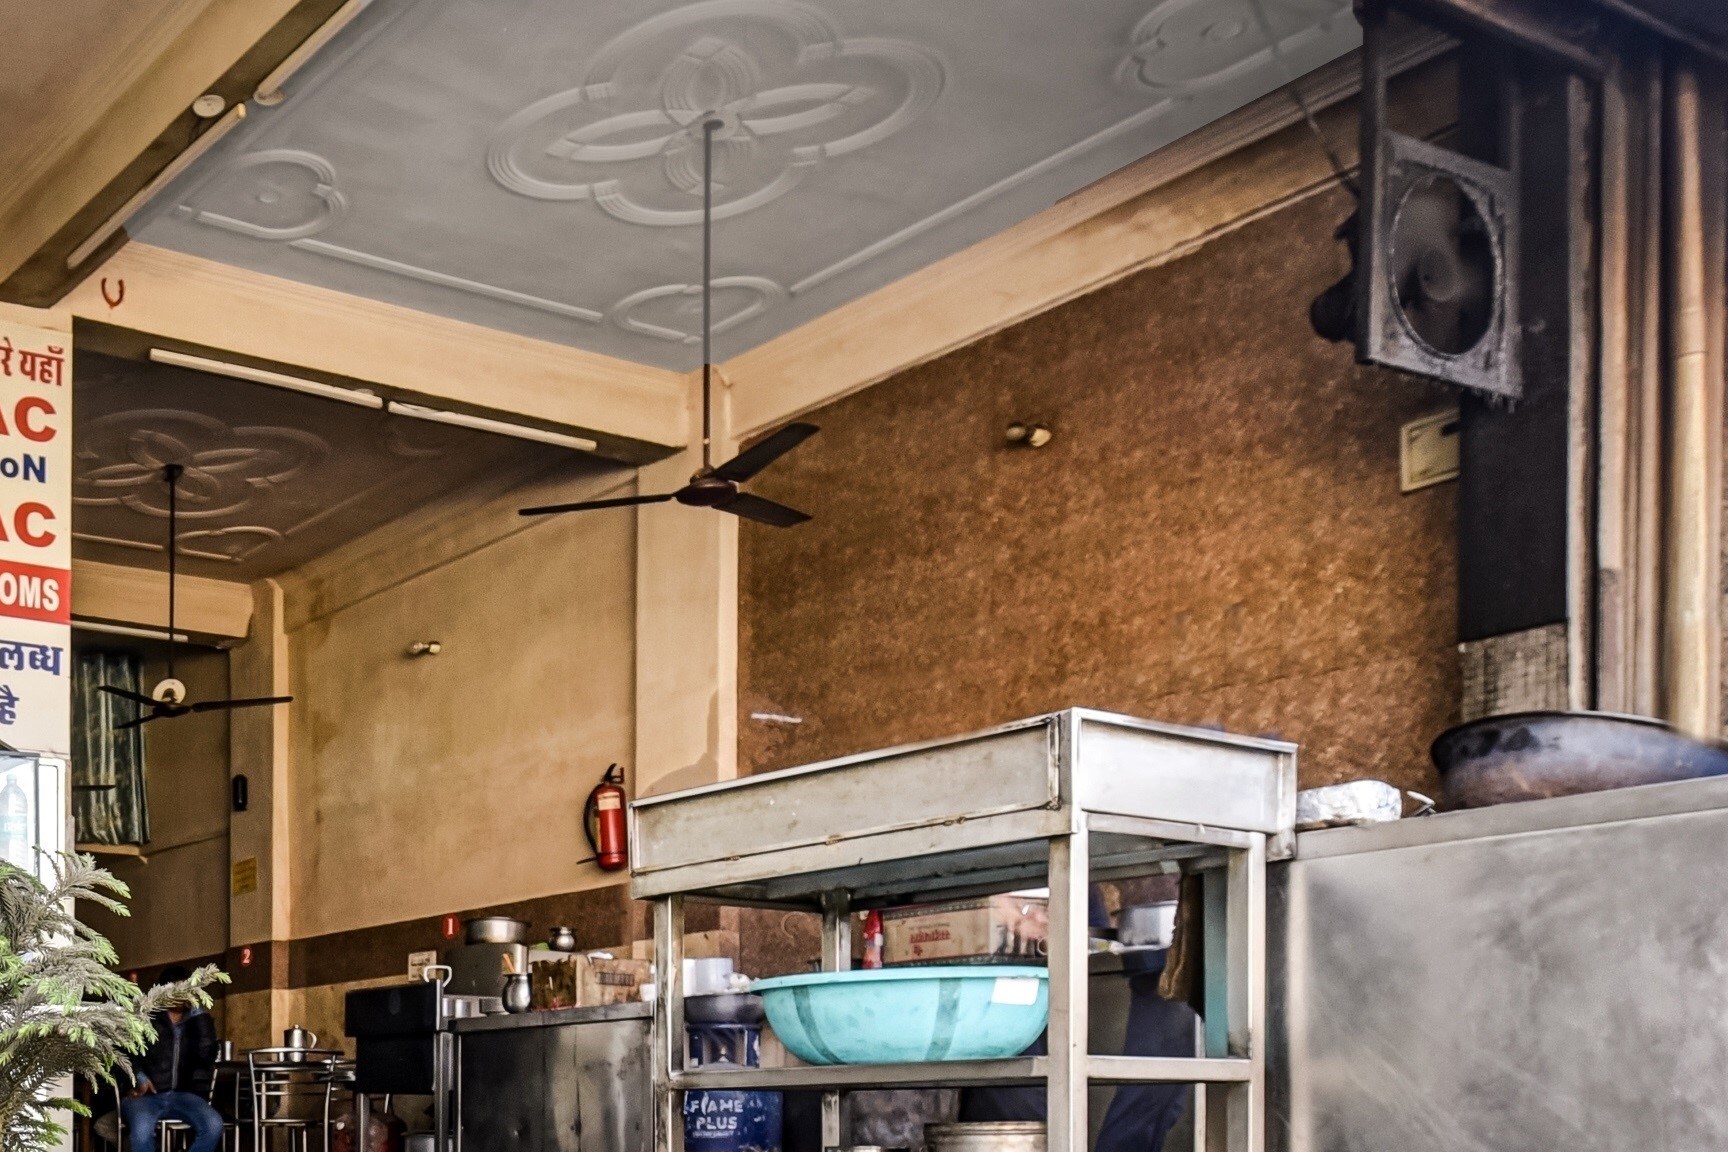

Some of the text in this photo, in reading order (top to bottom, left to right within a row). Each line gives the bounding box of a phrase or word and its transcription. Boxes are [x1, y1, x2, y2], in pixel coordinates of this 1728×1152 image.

[18, 345, 65, 387] यहाँ
[241, 948, 252, 964] 2
[696, 1116, 738, 1130] PLUS
